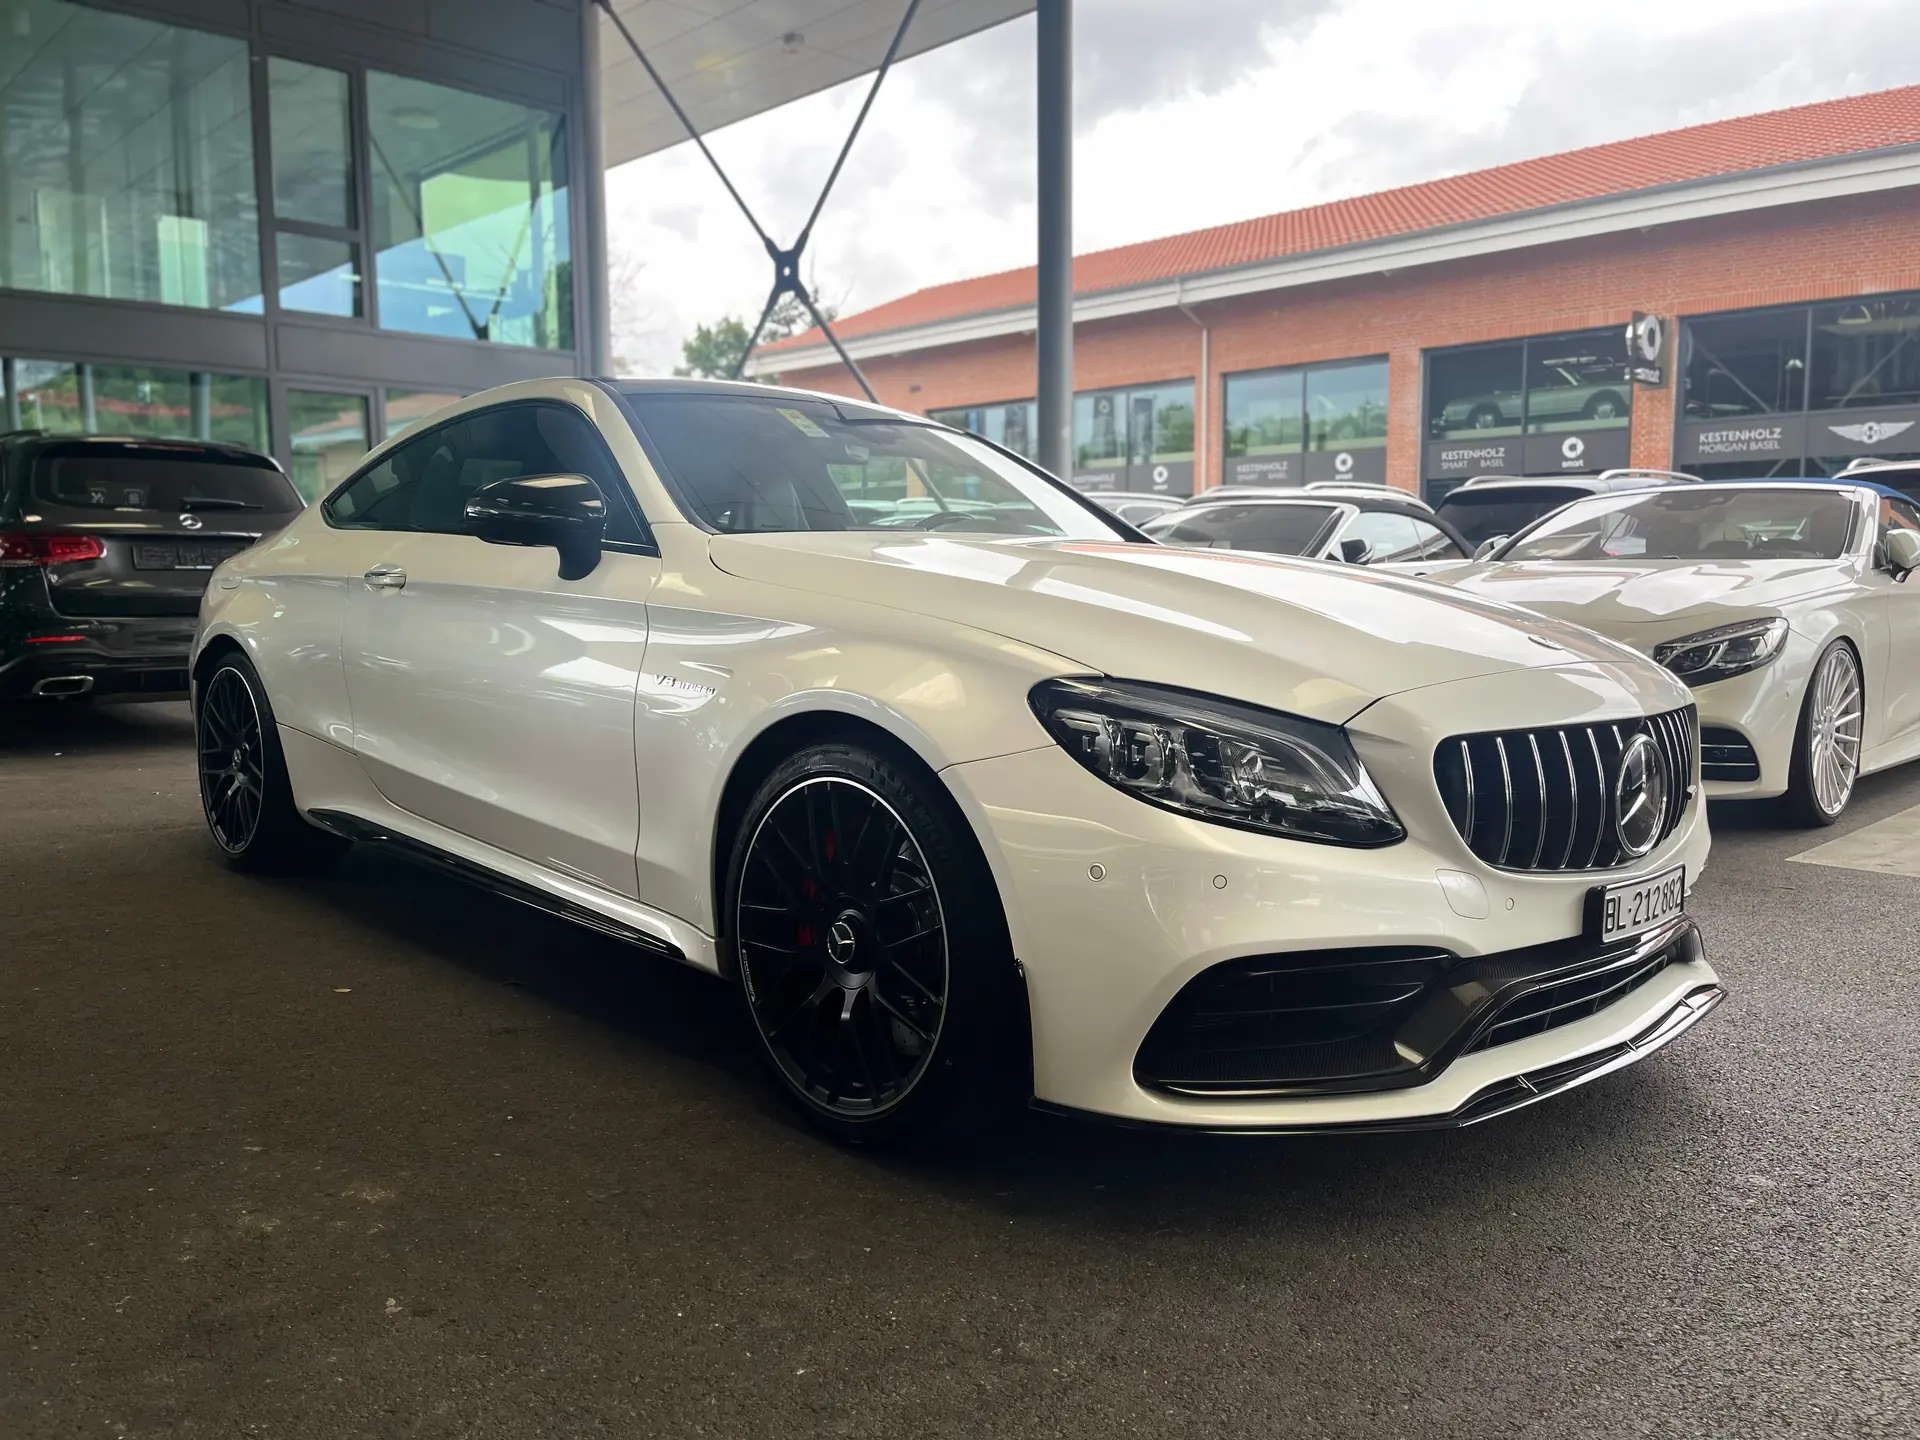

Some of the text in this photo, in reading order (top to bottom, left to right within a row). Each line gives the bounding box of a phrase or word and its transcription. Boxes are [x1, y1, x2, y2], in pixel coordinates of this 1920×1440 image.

[1699, 428, 1782, 443] KESTENHOLZ
[1699, 440, 1781, 454] MORGAN BASEL
[1441, 448, 1505, 460] KESTENHOLZ
[1441, 458, 1504, 470] SMART BASEL
[1561, 459, 1584, 468] smart
[653, 674, 676, 687] V8
